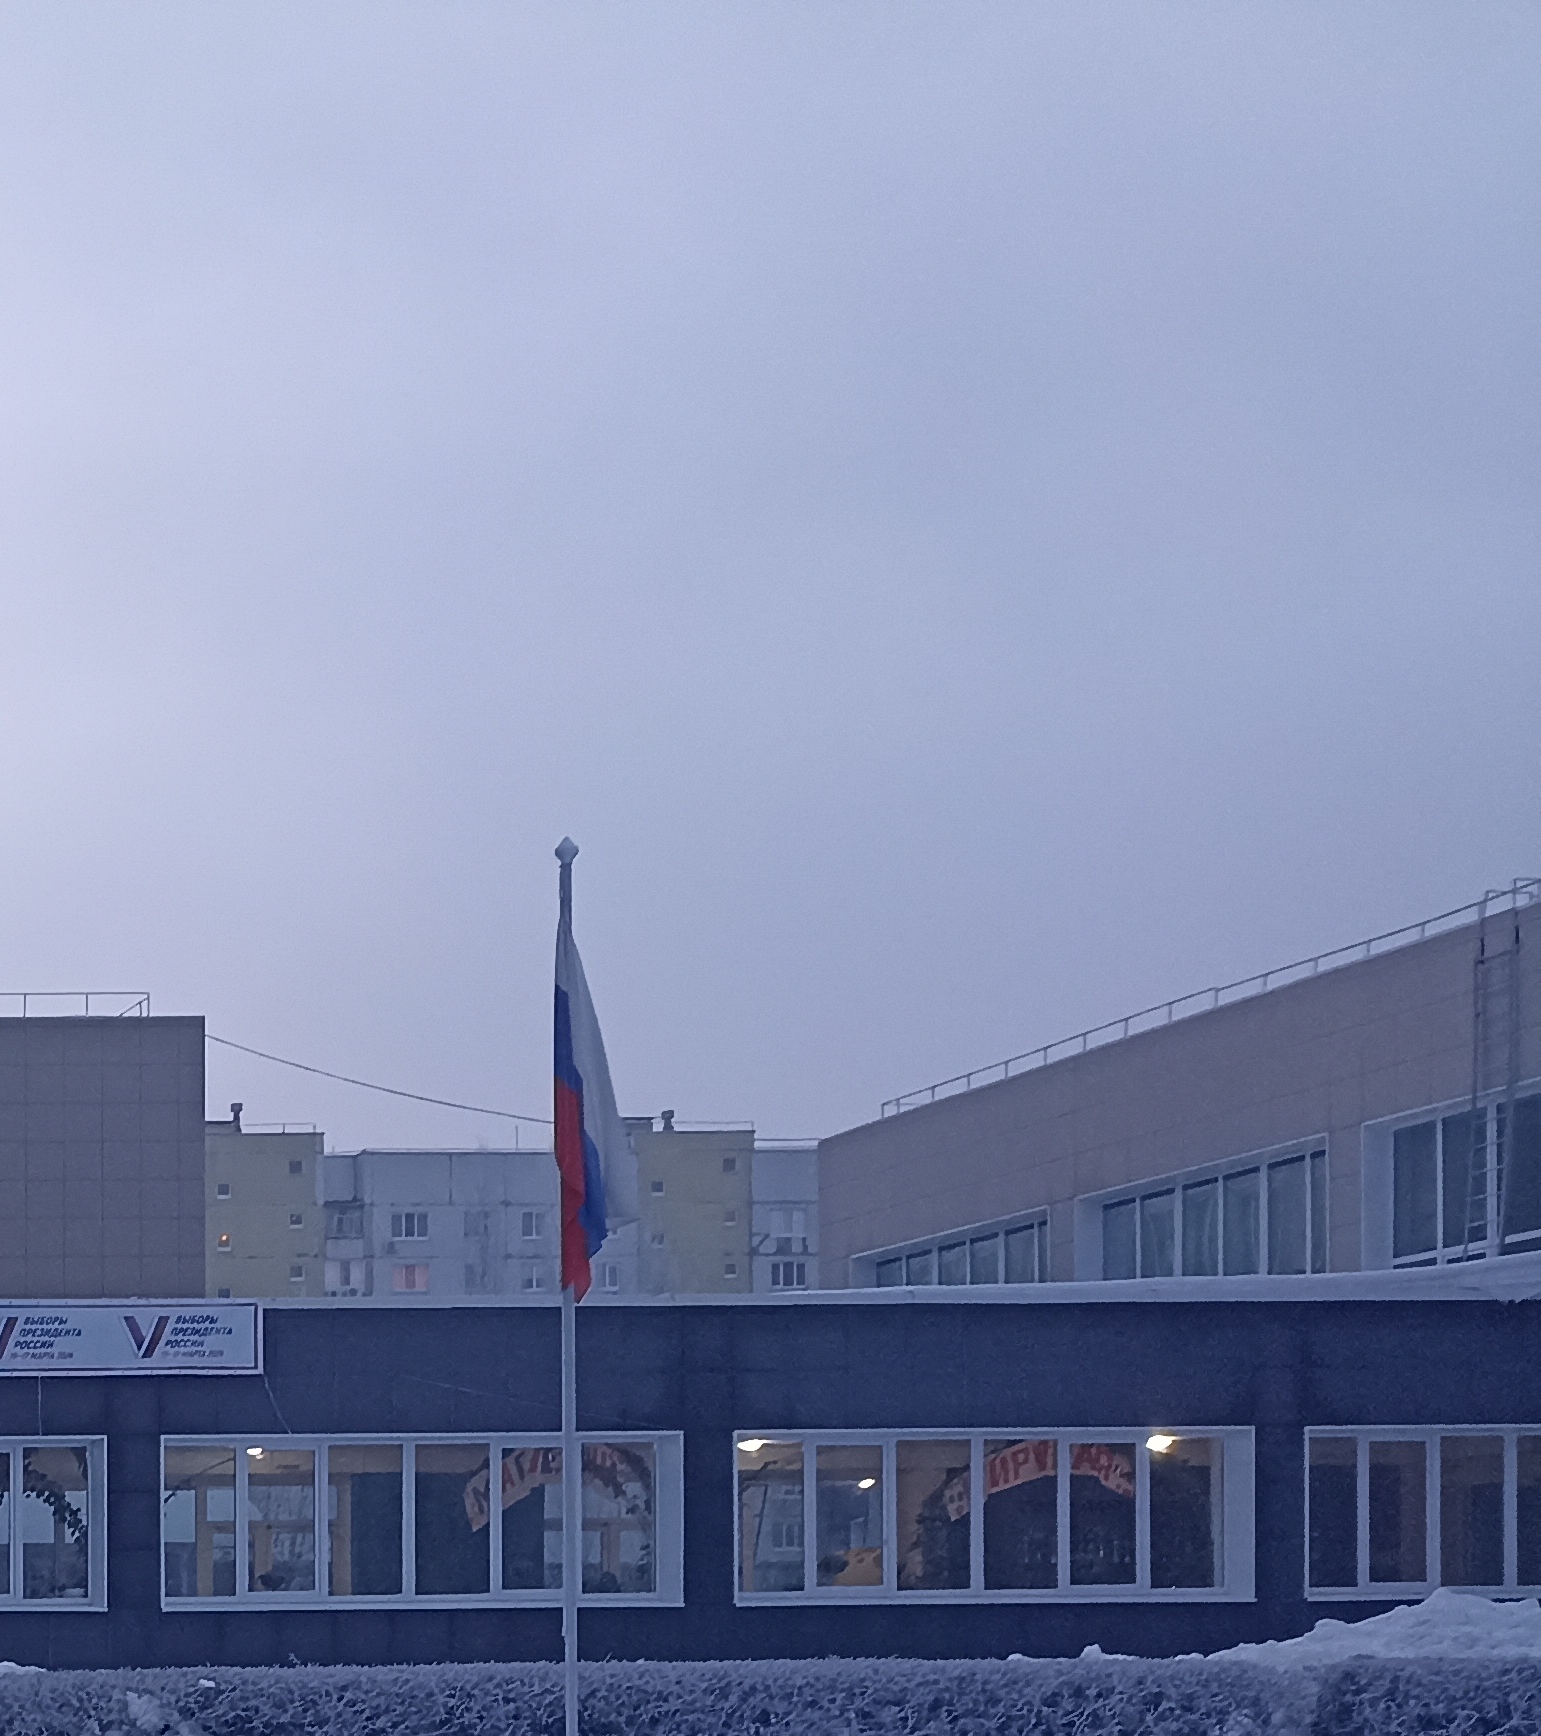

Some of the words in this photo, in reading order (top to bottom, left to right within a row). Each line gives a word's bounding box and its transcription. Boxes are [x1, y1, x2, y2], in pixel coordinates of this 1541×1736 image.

[23, 1316, 68, 1326] ВЫБОРЫ
[174, 1315, 219, 1325] ВЫБОРЫ
[19, 1328, 82, 1338] ПРЕЗИДЕНТА
[170, 1327, 233, 1337] ПРЕЗИДЕНТА
[14, 1340, 55, 1350] РОССИИ
[164, 1339, 205, 1349] РОССИИ
